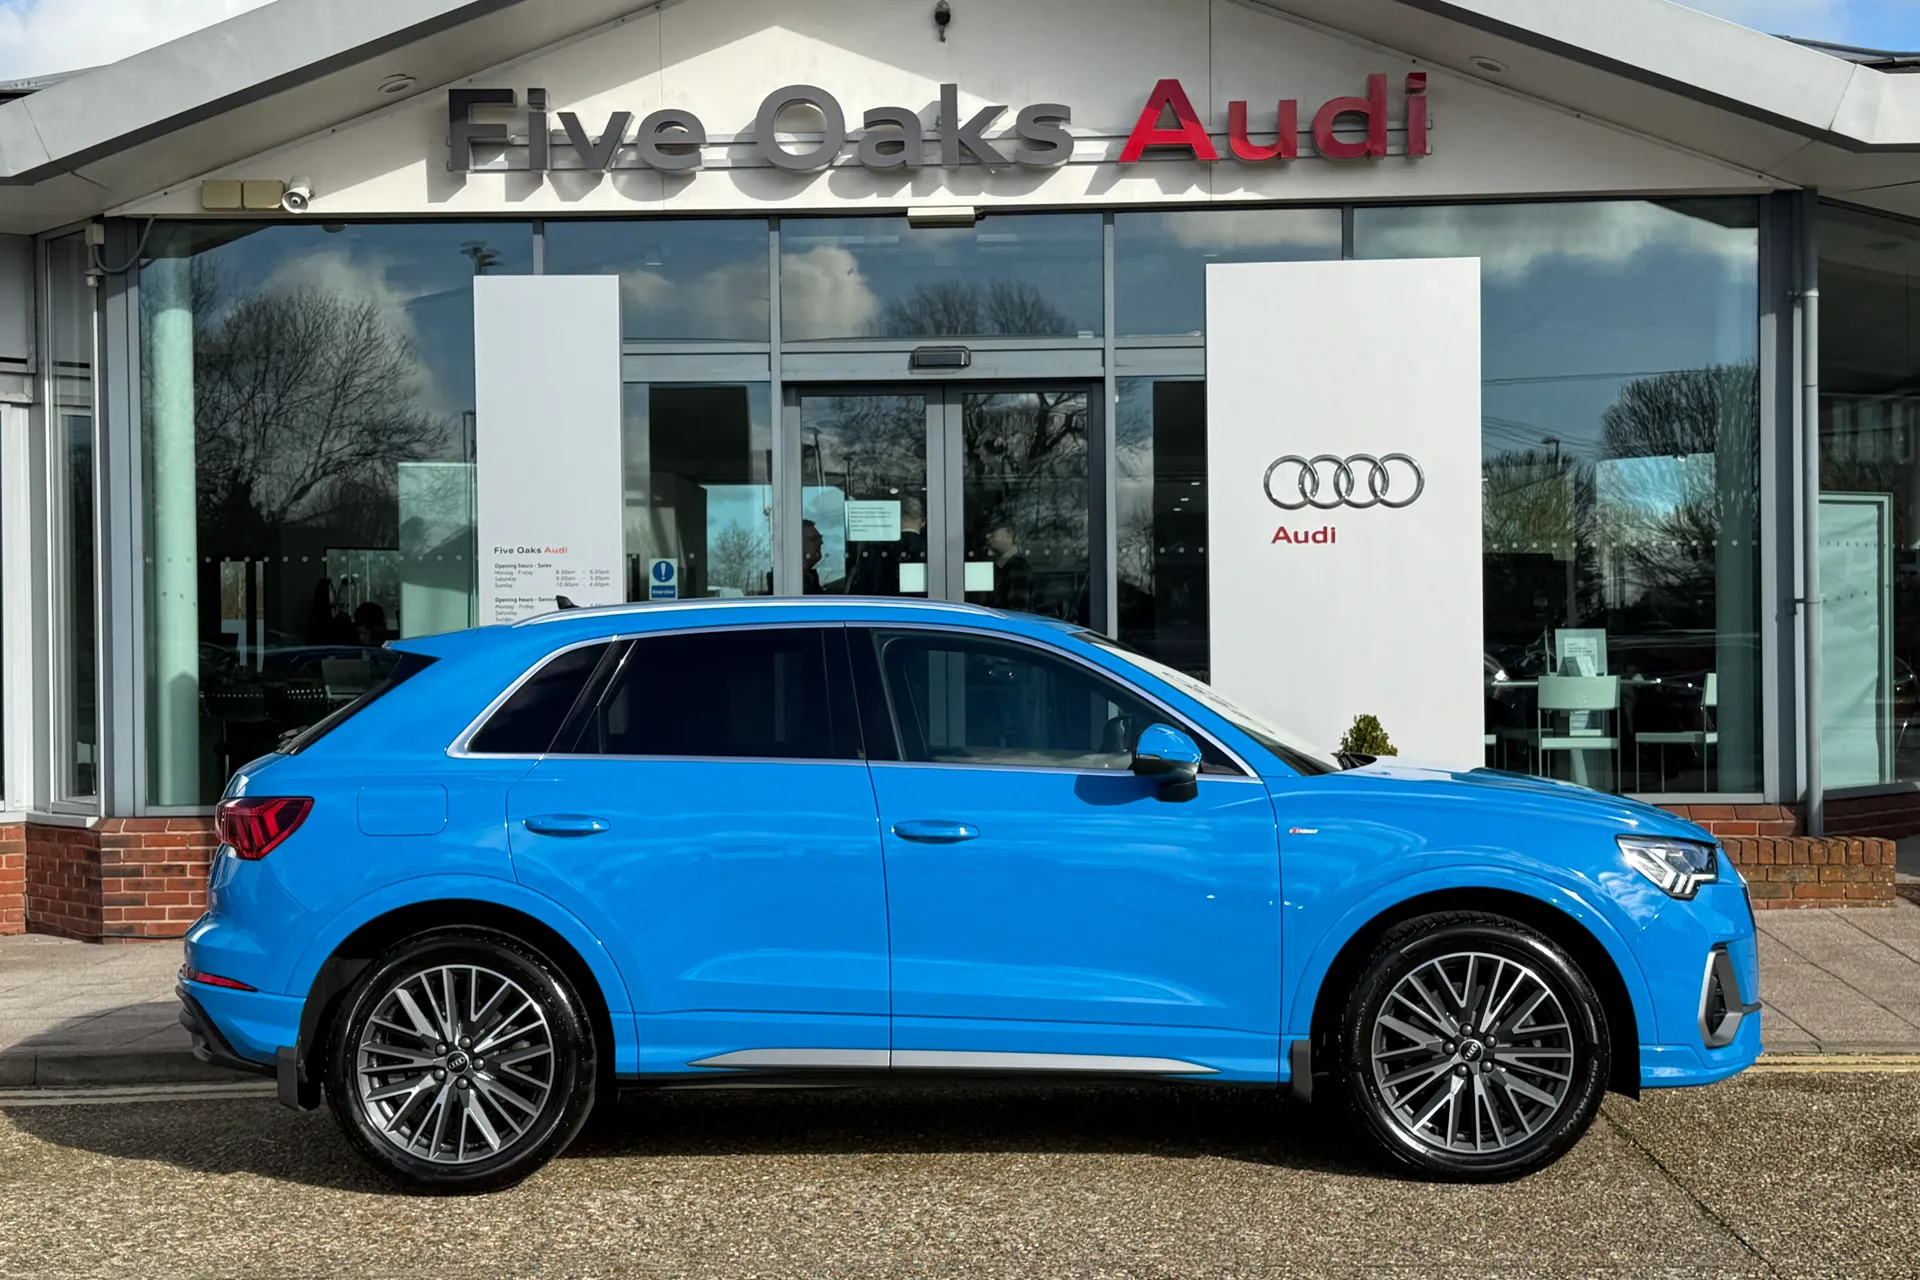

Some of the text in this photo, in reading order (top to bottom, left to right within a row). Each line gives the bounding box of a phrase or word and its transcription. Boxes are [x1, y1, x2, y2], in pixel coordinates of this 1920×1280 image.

[448, 72, 1427, 172] Five Oaks Audi
[1271, 526, 1336, 544] Audi
[494, 546, 568, 554] Five Oaks Audi
